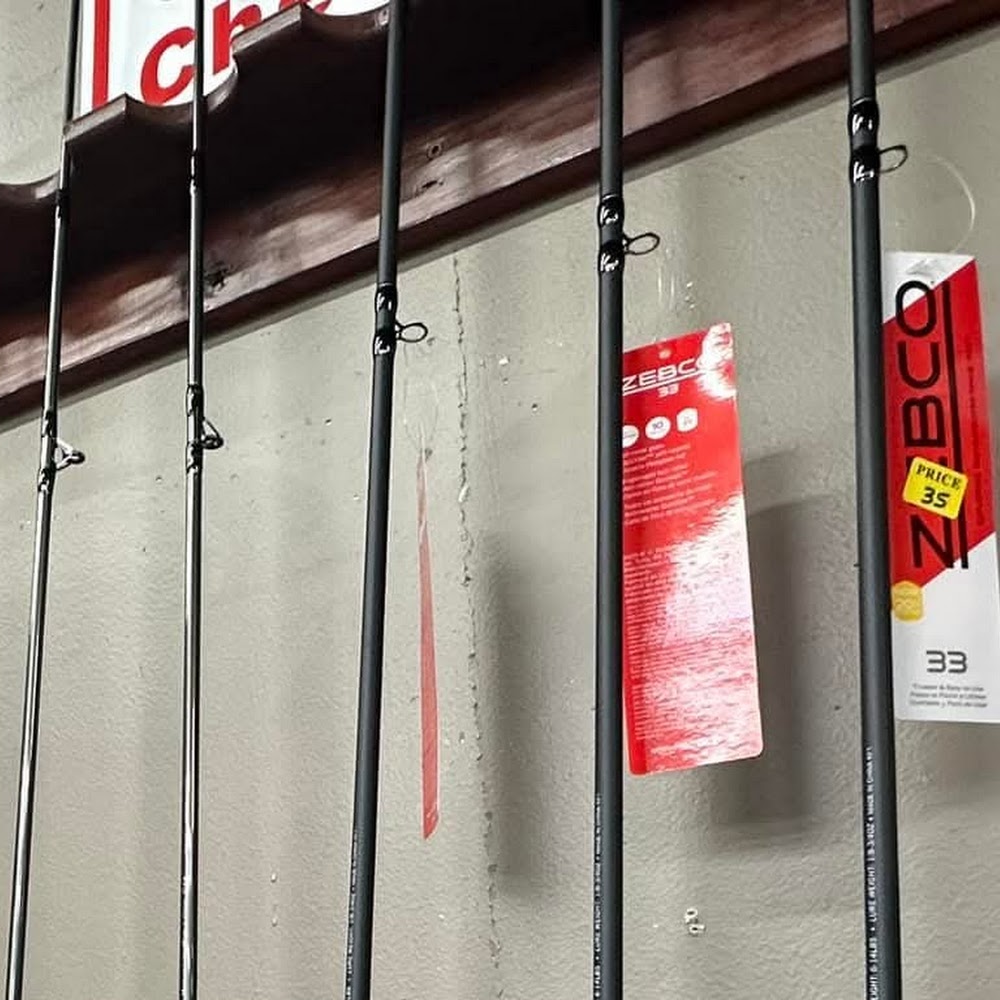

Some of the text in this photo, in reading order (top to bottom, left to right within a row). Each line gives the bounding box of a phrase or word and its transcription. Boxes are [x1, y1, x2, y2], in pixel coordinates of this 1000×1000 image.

[622, 357, 712, 392] ZEBC
[895, 280, 954, 568] ZBCO
[916, 464, 963, 491] PRICE
[921, 486, 951, 508] 35
[926, 650, 968, 674] 33
